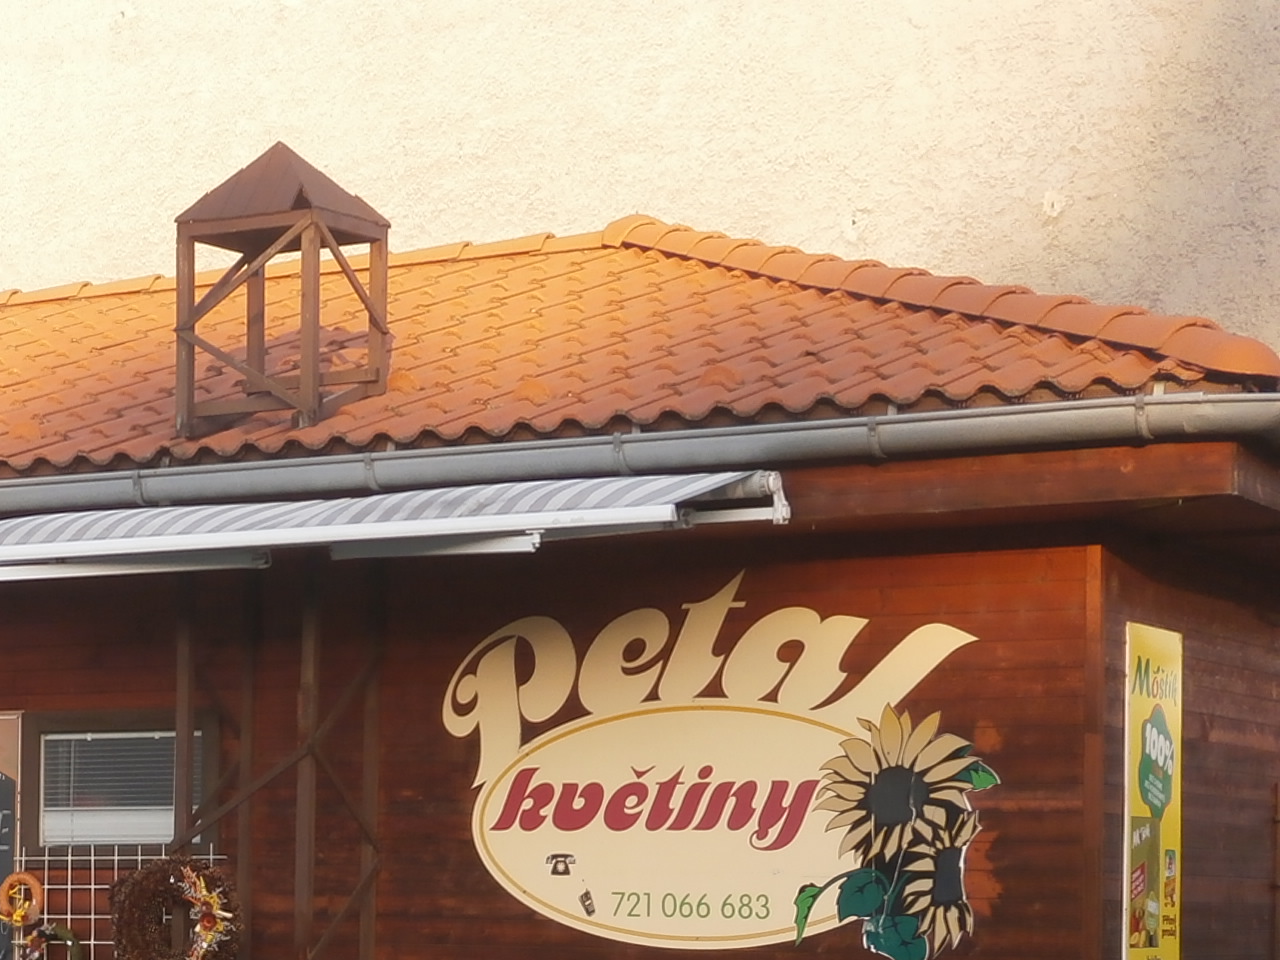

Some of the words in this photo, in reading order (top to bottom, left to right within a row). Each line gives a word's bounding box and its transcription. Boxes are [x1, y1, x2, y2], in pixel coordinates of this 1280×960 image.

[1145, 722, 1174, 776] 100%
[489, 765, 820, 851] květiny
[611, 892, 651, 917] 721
[661, 892, 711, 918] 066
[721, 893, 771, 920] 683
